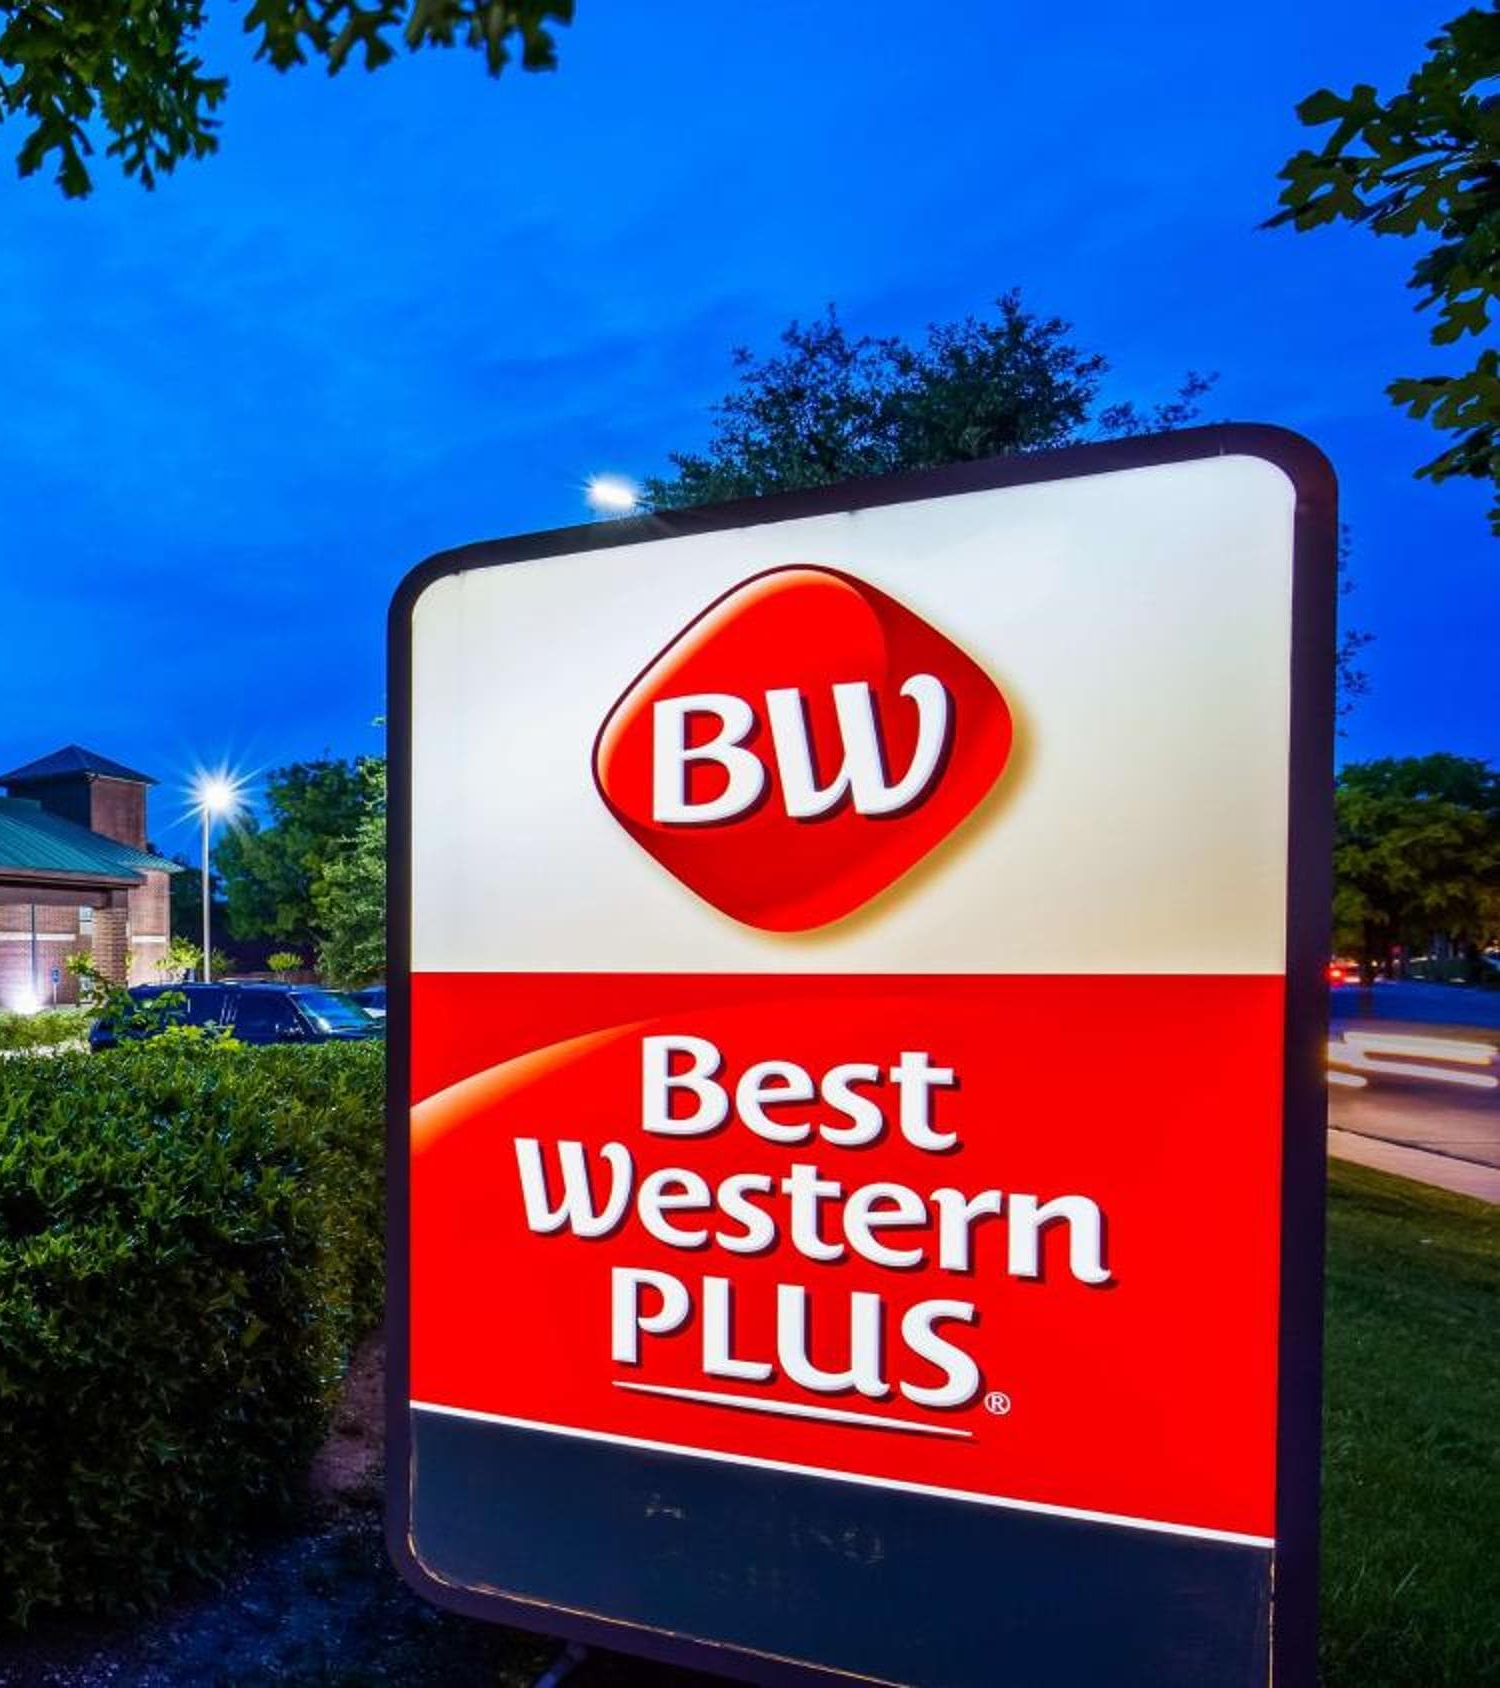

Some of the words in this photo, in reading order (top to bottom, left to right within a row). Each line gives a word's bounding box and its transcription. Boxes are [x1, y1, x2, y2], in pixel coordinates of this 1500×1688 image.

[653, 673, 949, 824] BW
[641, 1034, 958, 1151] Best
[513, 1137, 1112, 1284] Western
